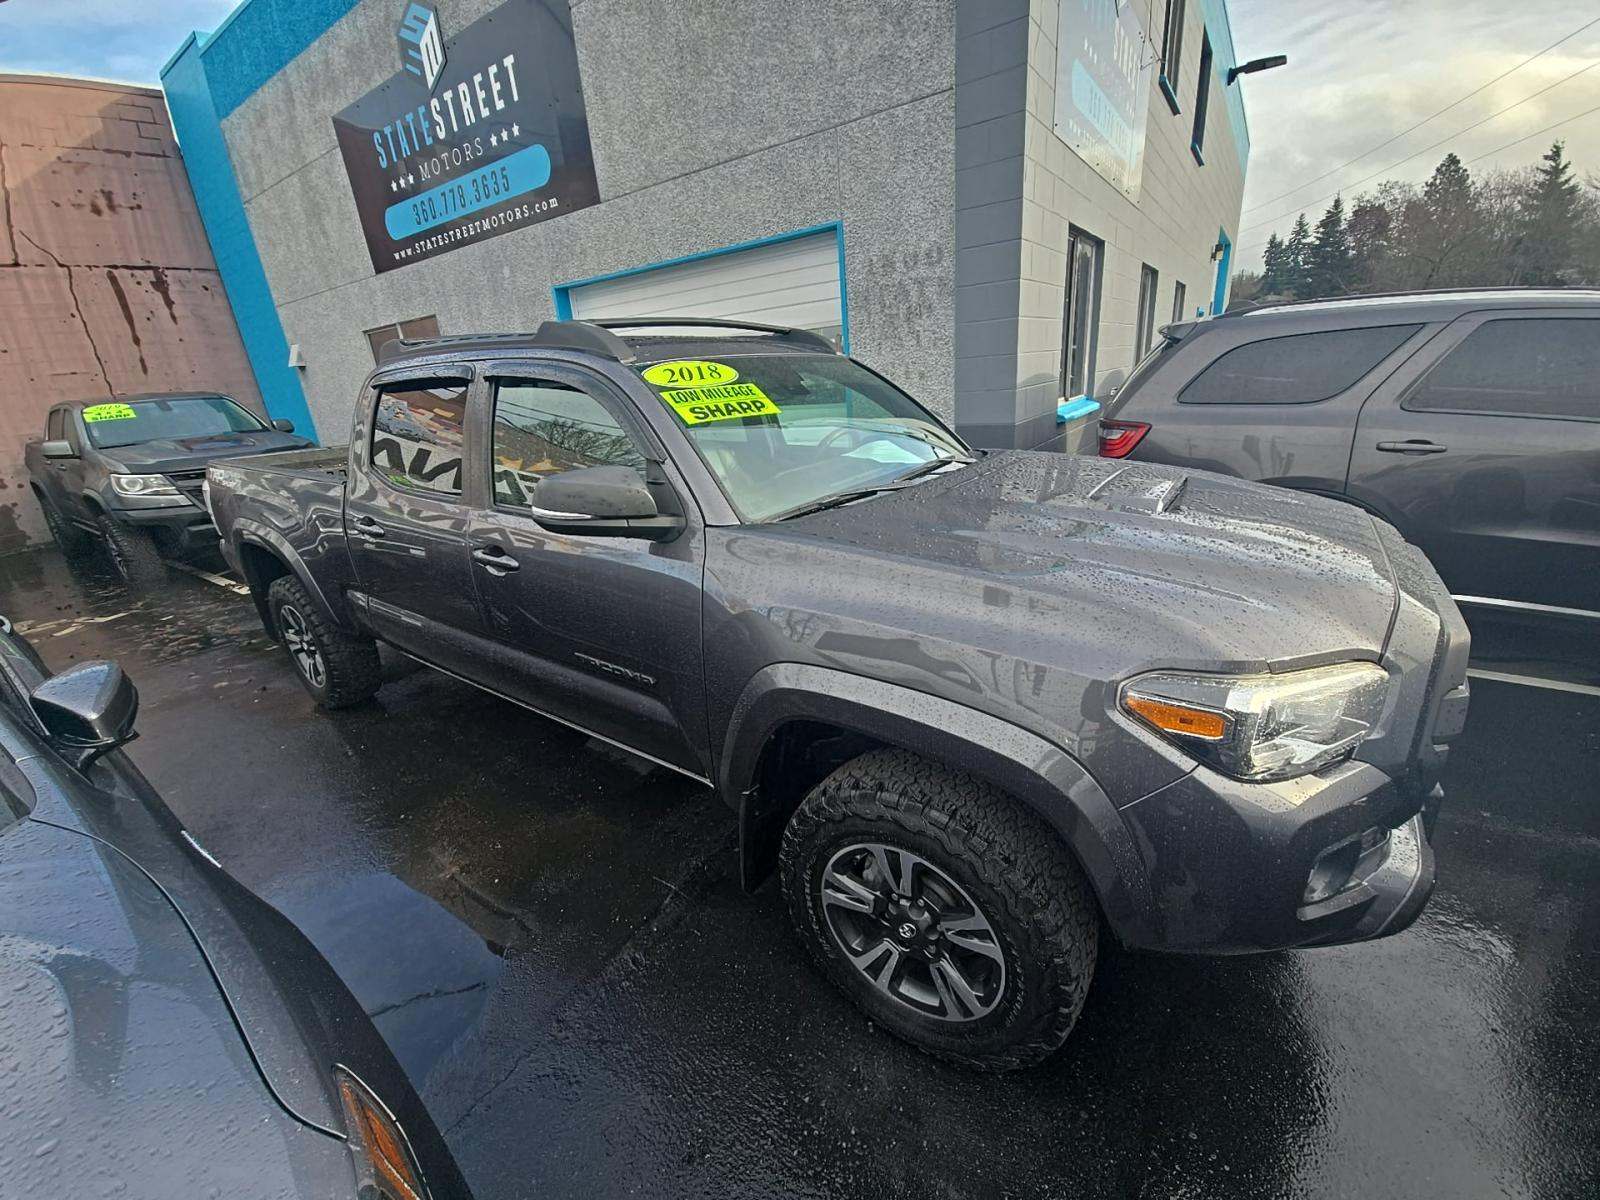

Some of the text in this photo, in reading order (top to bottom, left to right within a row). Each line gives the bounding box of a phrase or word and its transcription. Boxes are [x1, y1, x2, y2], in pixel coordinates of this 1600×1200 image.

[419, 137, 484, 181] MOTORS
[412, 166, 510, 226] 360.778.3635
[393, 197, 559, 260] www.STATESTREETMOTORS.com
[662, 364, 722, 384] 2018
[669, 385, 757, 404] LOW MILEAGE
[689, 399, 766, 420] SHARP
